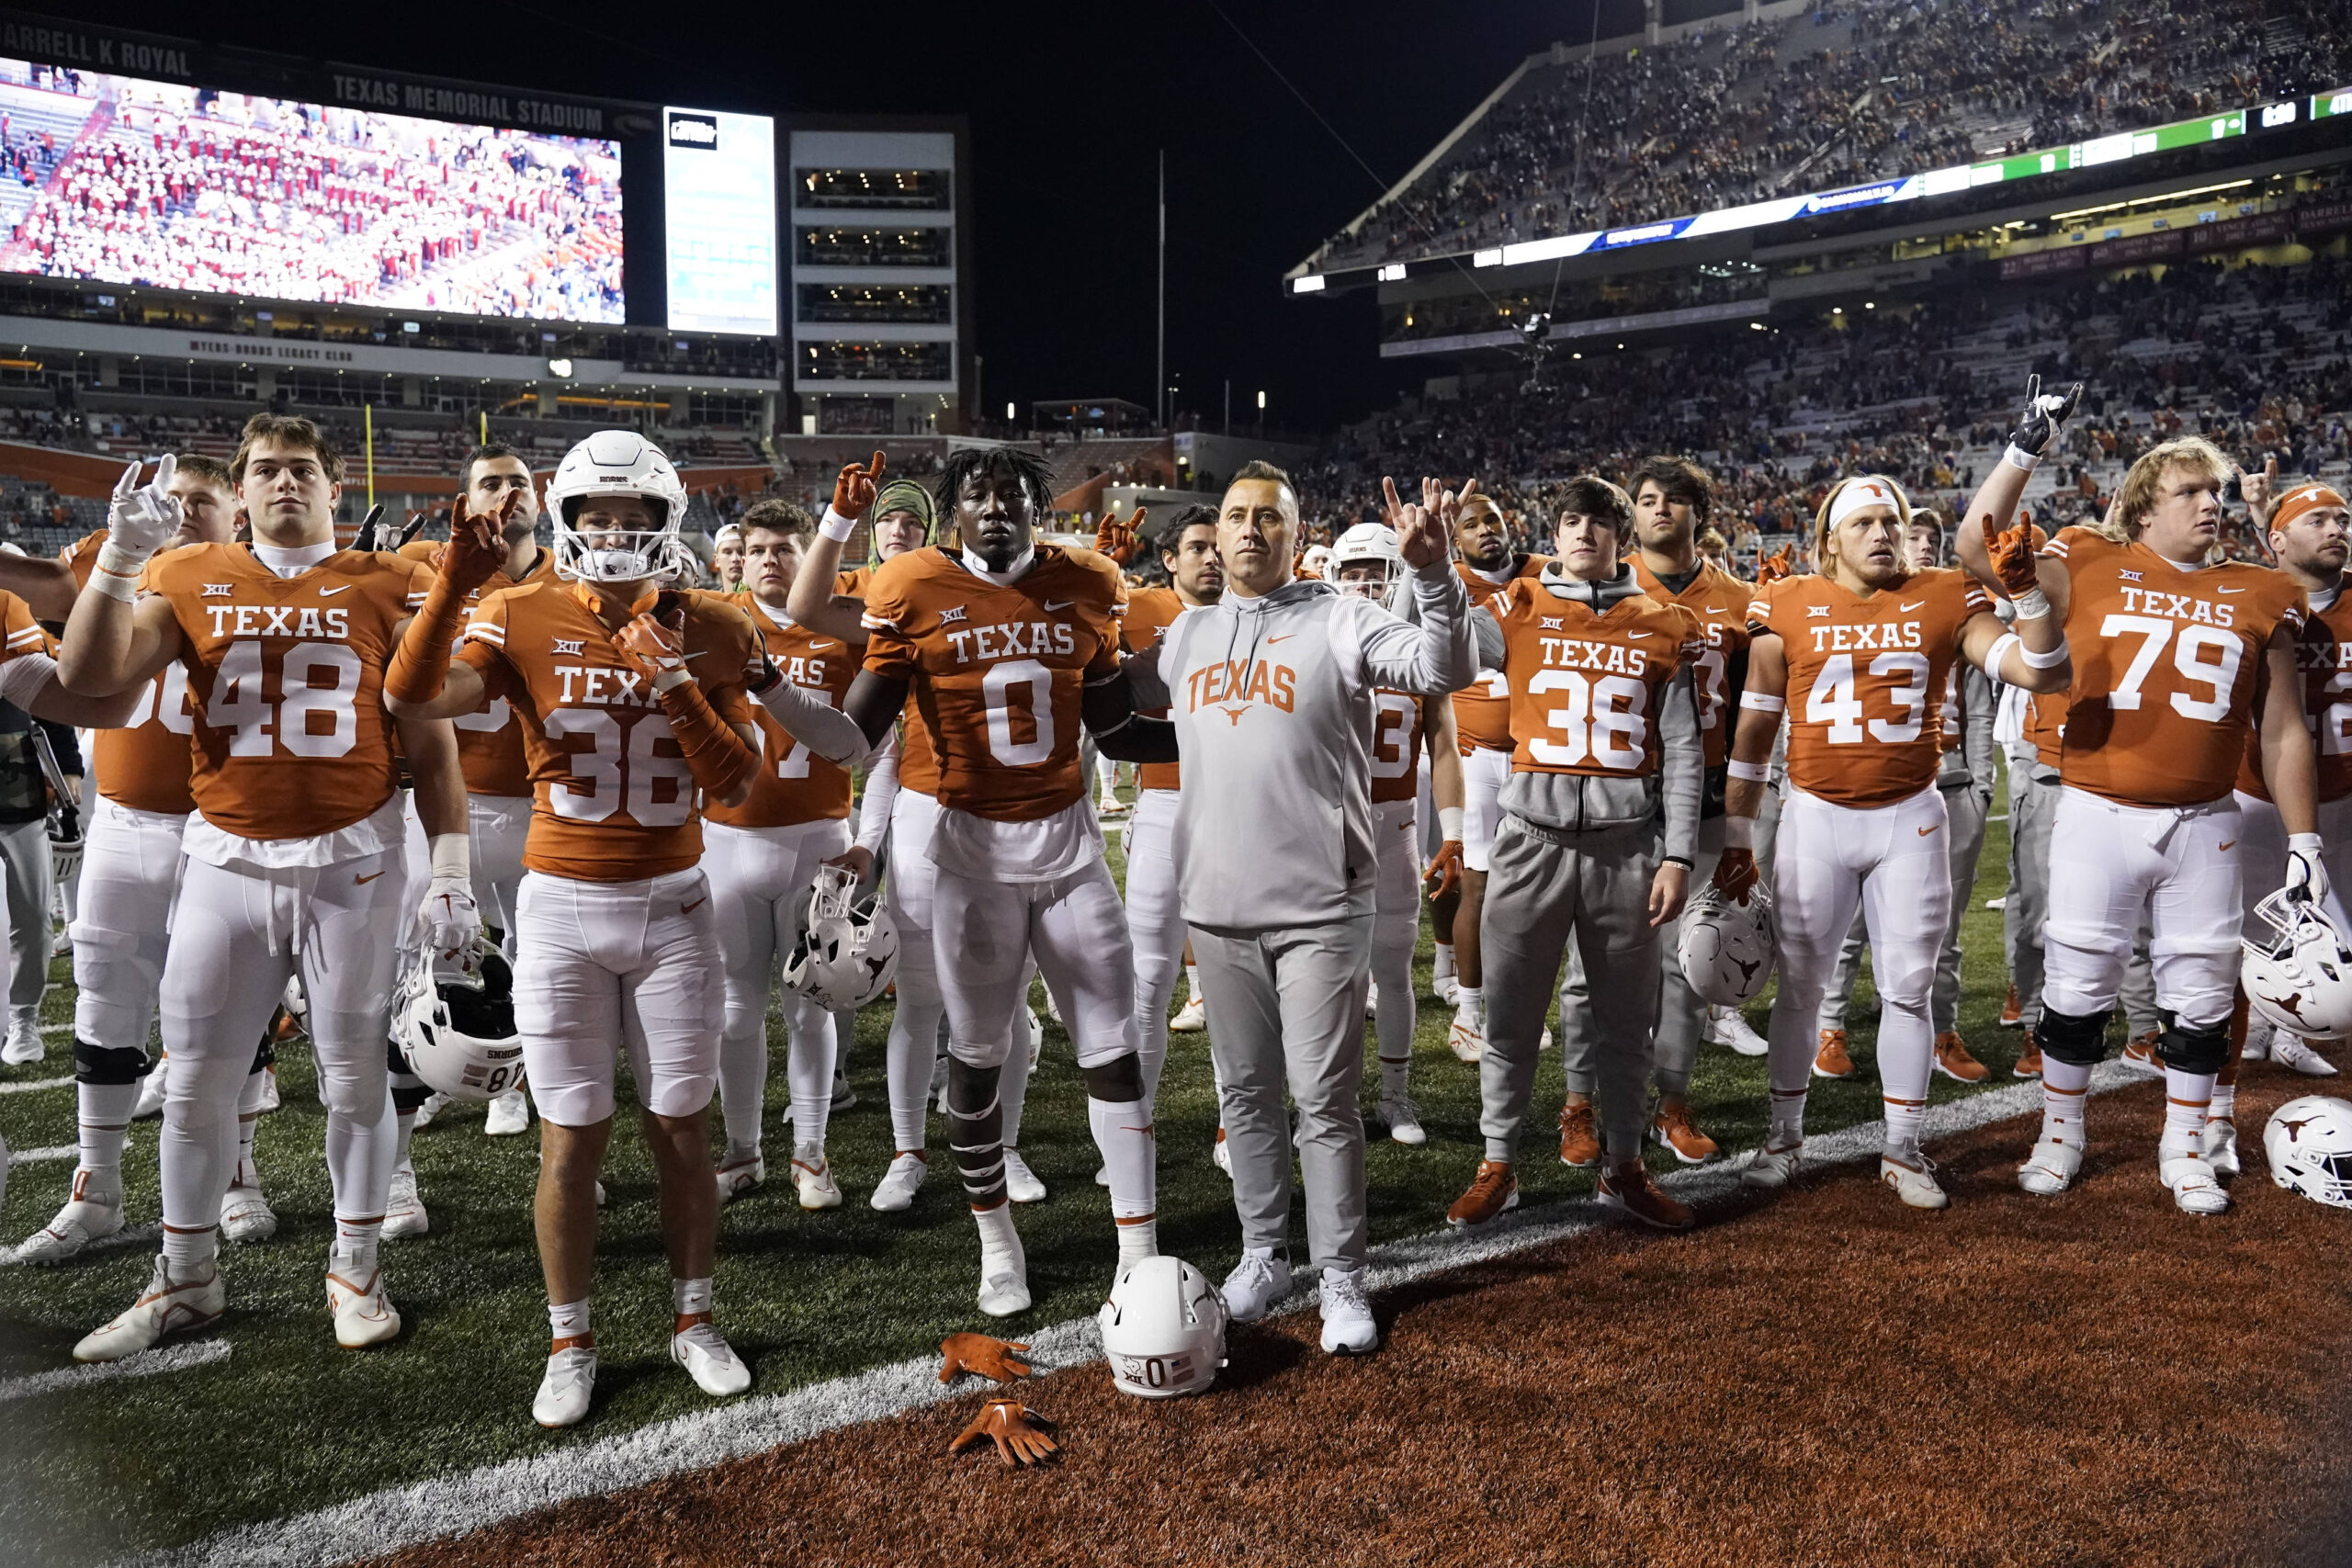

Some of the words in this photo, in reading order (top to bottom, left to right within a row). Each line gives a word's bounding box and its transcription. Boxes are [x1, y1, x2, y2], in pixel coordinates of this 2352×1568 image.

[1, 24, 92, 62] ARRELL
[99, 39, 114, 65] K
[121, 43, 191, 76] ROYAL
[334, 75, 399, 107] TEXAS
[405, 85, 512, 121] MEMORIAL
[517, 100, 604, 132] STADIUM
[206, 605, 349, 639] TEXAS
[2120, 586, 2234, 627] TEXAS
[946, 622, 1075, 664] TEXAS
[1539, 637, 1647, 676] TEXAS
[1810, 621, 1922, 652] TEXAS
[2295, 641, 2352, 669] EXA
[768, 654, 826, 685] XAS
[1188, 659, 1297, 715] TEXAS
[2099, 615, 2244, 723] 79
[206, 640, 362, 758] 48
[982, 659, 1055, 767] 0
[1527, 669, 1647, 770] 38
[1805, 651, 1930, 744] 43
[1146, 1358, 1166, 1388] 0
